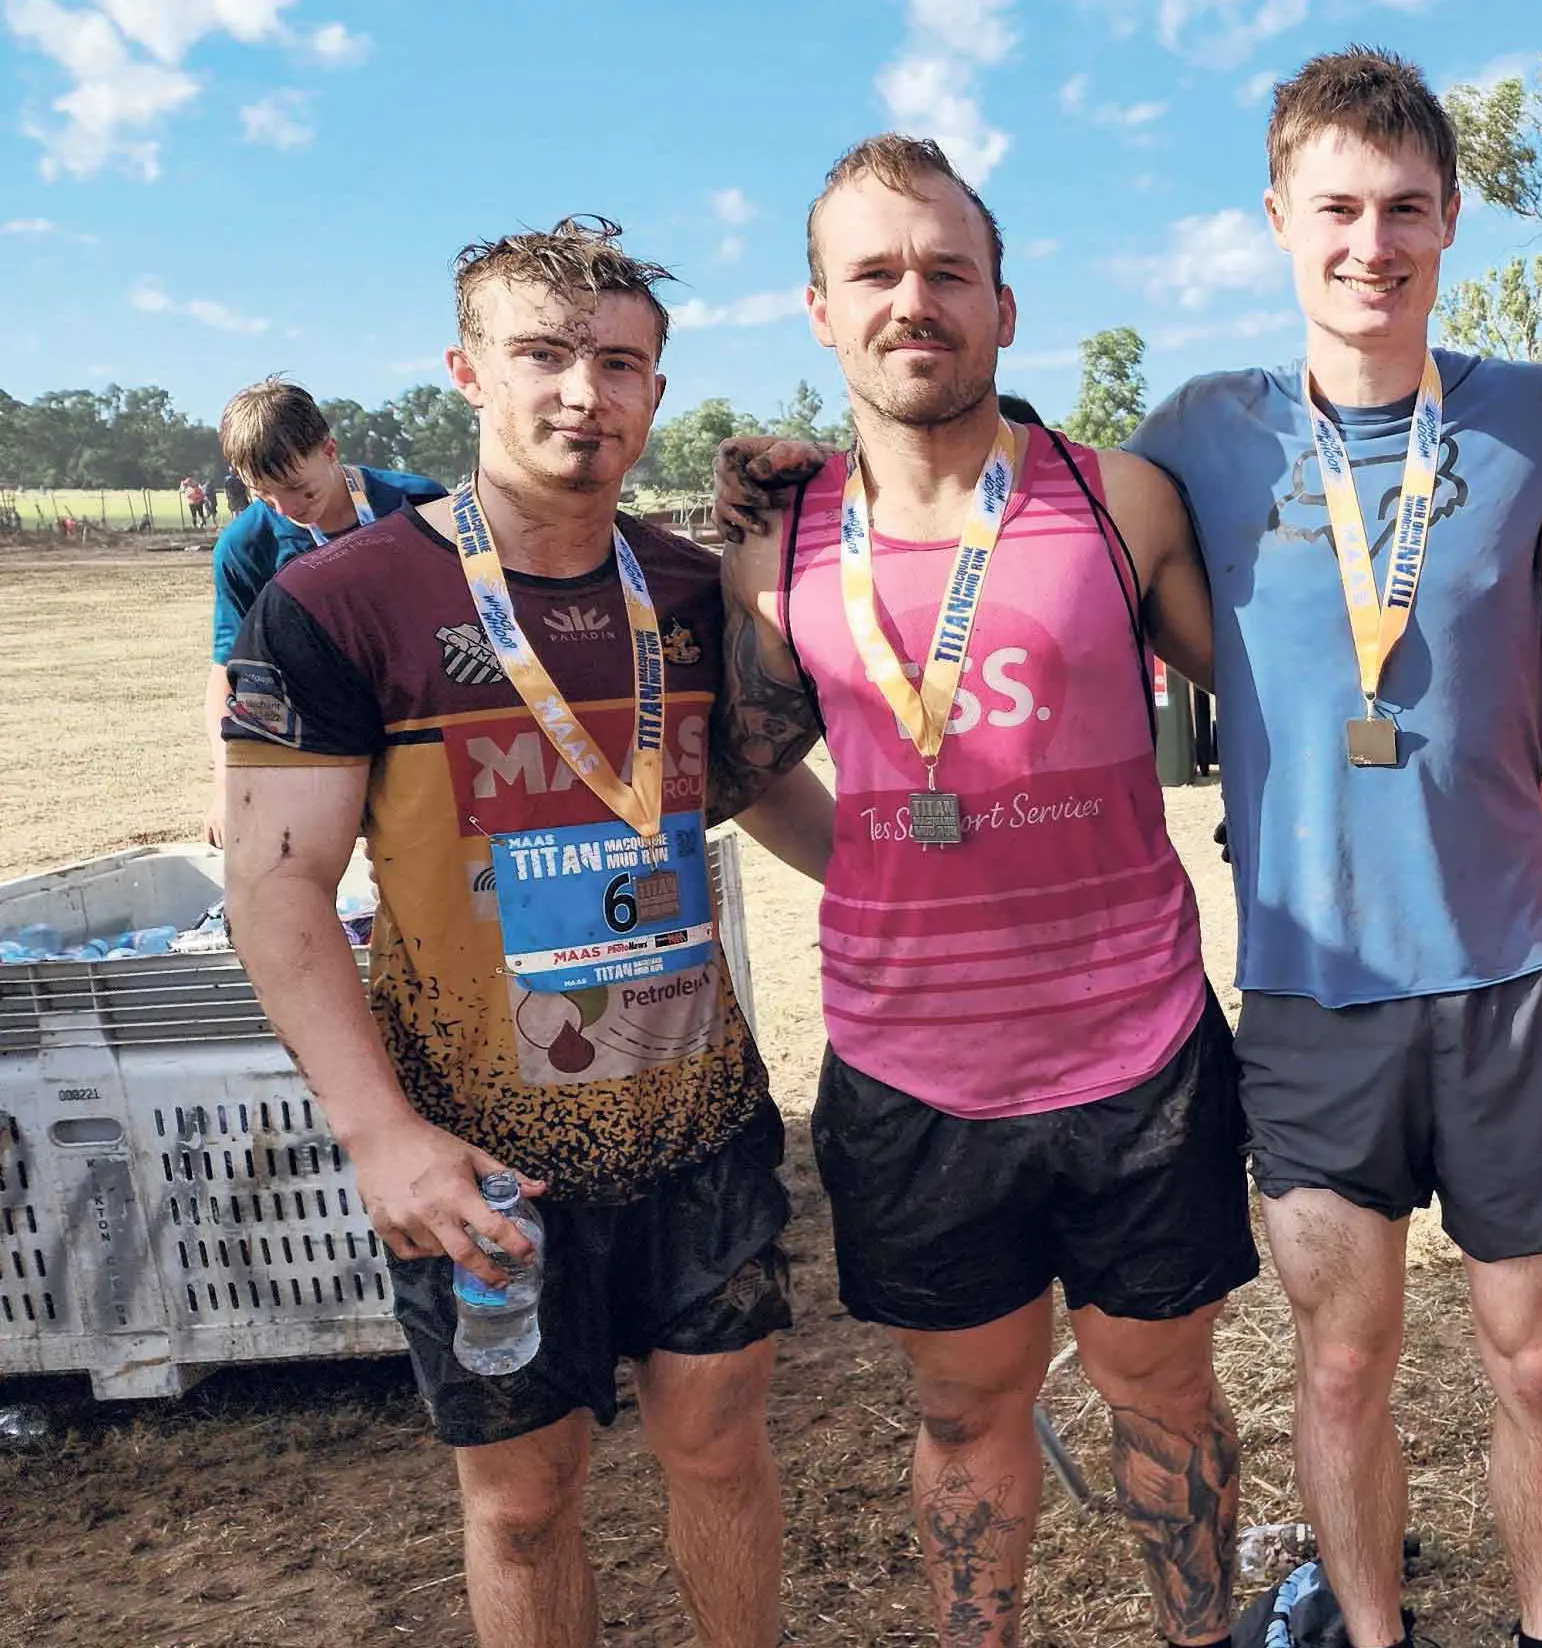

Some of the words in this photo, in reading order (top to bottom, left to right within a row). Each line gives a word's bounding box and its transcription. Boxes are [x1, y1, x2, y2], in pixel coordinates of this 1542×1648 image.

[1418, 420, 1430, 458] WHOOP
[982, 472, 995, 513] WHOOP
[1415, 495, 1429, 518] RUN
[1400, 494, 1415, 545] MACQUARIE
[1412, 522, 1426, 547] MUD
[461, 535, 479, 559] RUN
[971, 548, 988, 572] RUN
[951, 546, 974, 596] MACQUARIE
[964, 573, 981, 599] MUD
[1388, 546, 1421, 608] TITAN
[481, 612, 518, 650] WHOOP
[482, 595, 516, 633] WHOOP
[934, 596, 974, 664] TITAN
[648, 630, 661, 652] RUN
[534, 695, 599, 775] MAAS
[638, 682, 663, 751] TITAN
[860, 807, 890, 841] Tes
[1009, 793, 1103, 829] Services
[911, 800, 956, 816] TITAN
[508, 834, 556, 849] MAAS
[510, 841, 602, 880] TITAN
[607, 850, 638, 869] MUD
[603, 872, 639, 935] 6
[553, 946, 601, 965] MAAS
[593, 961, 633, 982] TITAN
